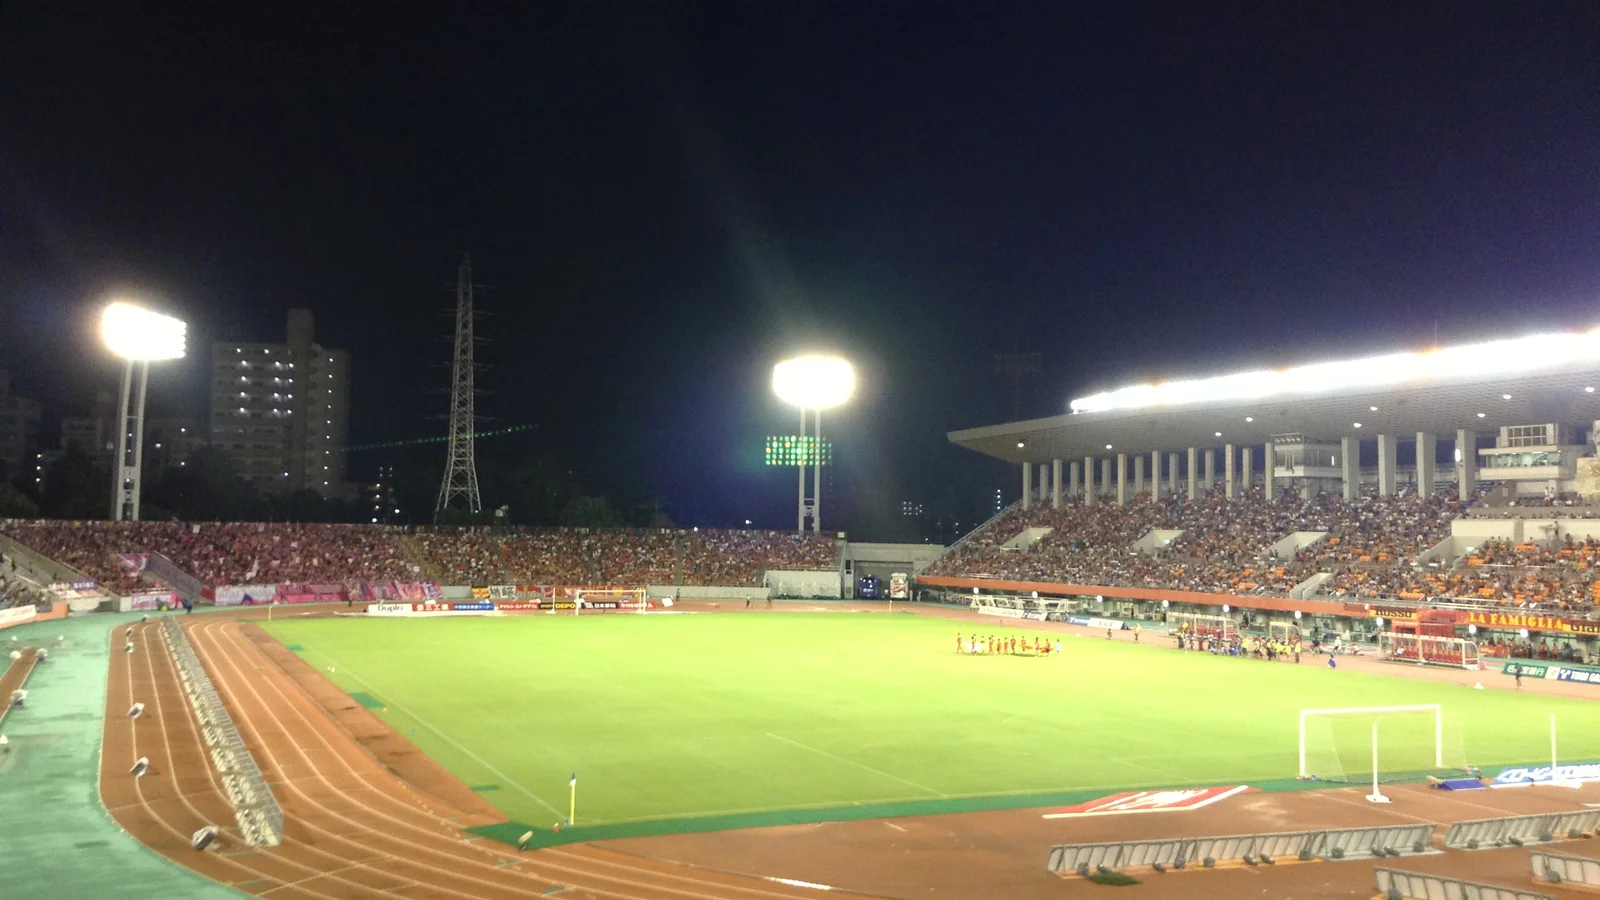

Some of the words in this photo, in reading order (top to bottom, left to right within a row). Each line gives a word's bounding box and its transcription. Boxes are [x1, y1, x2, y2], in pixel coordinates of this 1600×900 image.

[377, 604, 403, 612] Duplo
[1469, 612, 1486, 623] LA
[1490, 613, 1564, 629] FAMIGLIA
